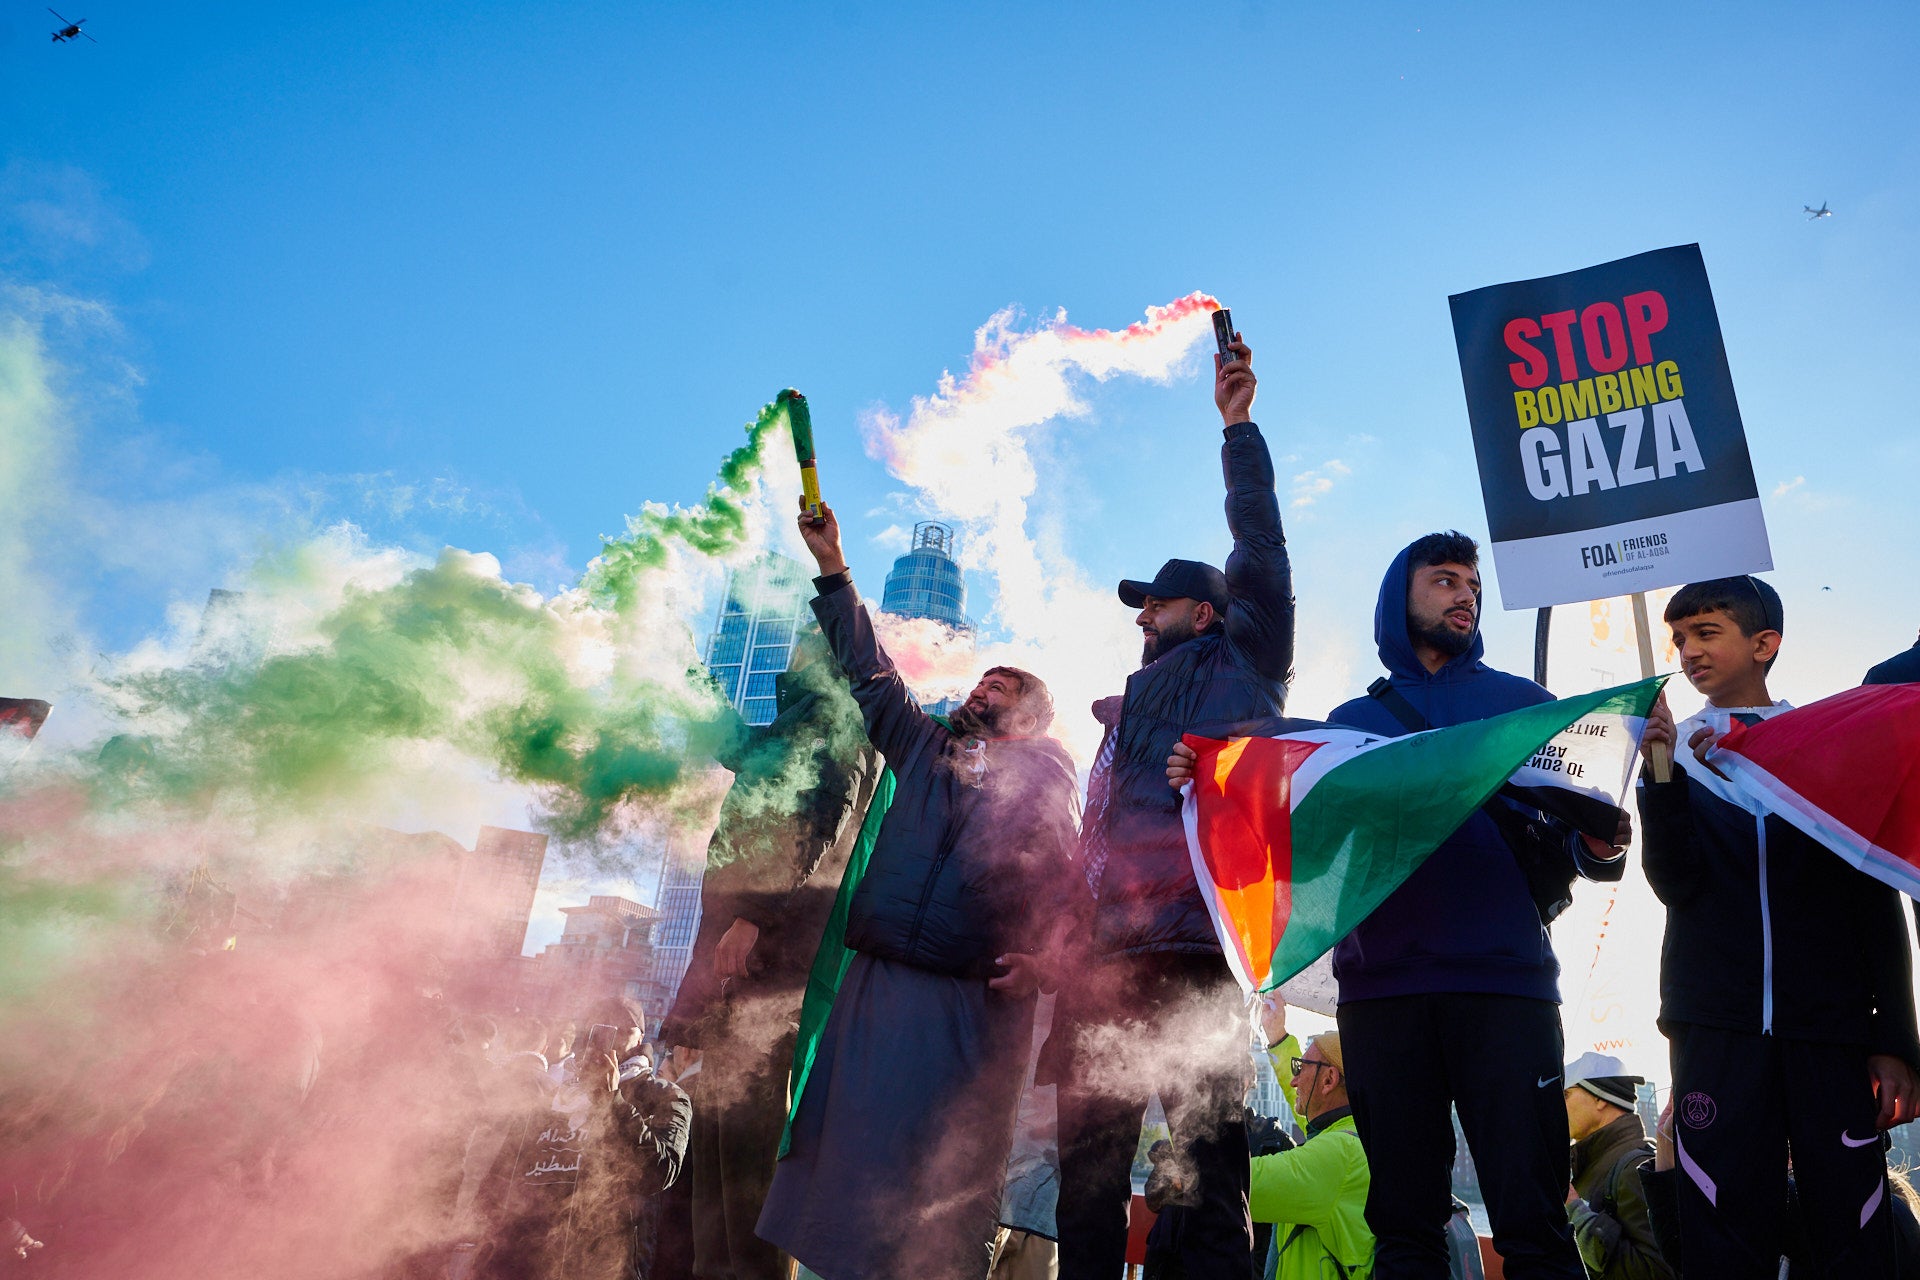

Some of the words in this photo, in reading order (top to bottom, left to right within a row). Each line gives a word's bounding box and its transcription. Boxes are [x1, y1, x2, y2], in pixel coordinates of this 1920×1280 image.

[1503, 290, 1669, 389] STOP
[1513, 360, 1685, 429] BOMBING
[1519, 398, 1706, 501] GAZA
[1623, 533, 1668, 551] FRIENDS
[1625, 552, 1635, 562] OF
[1637, 546, 1670, 560] AL-AQSA
[1581, 543, 1617, 569] FOA
[1602, 564, 1654, 578] @friendsofalaqsa
